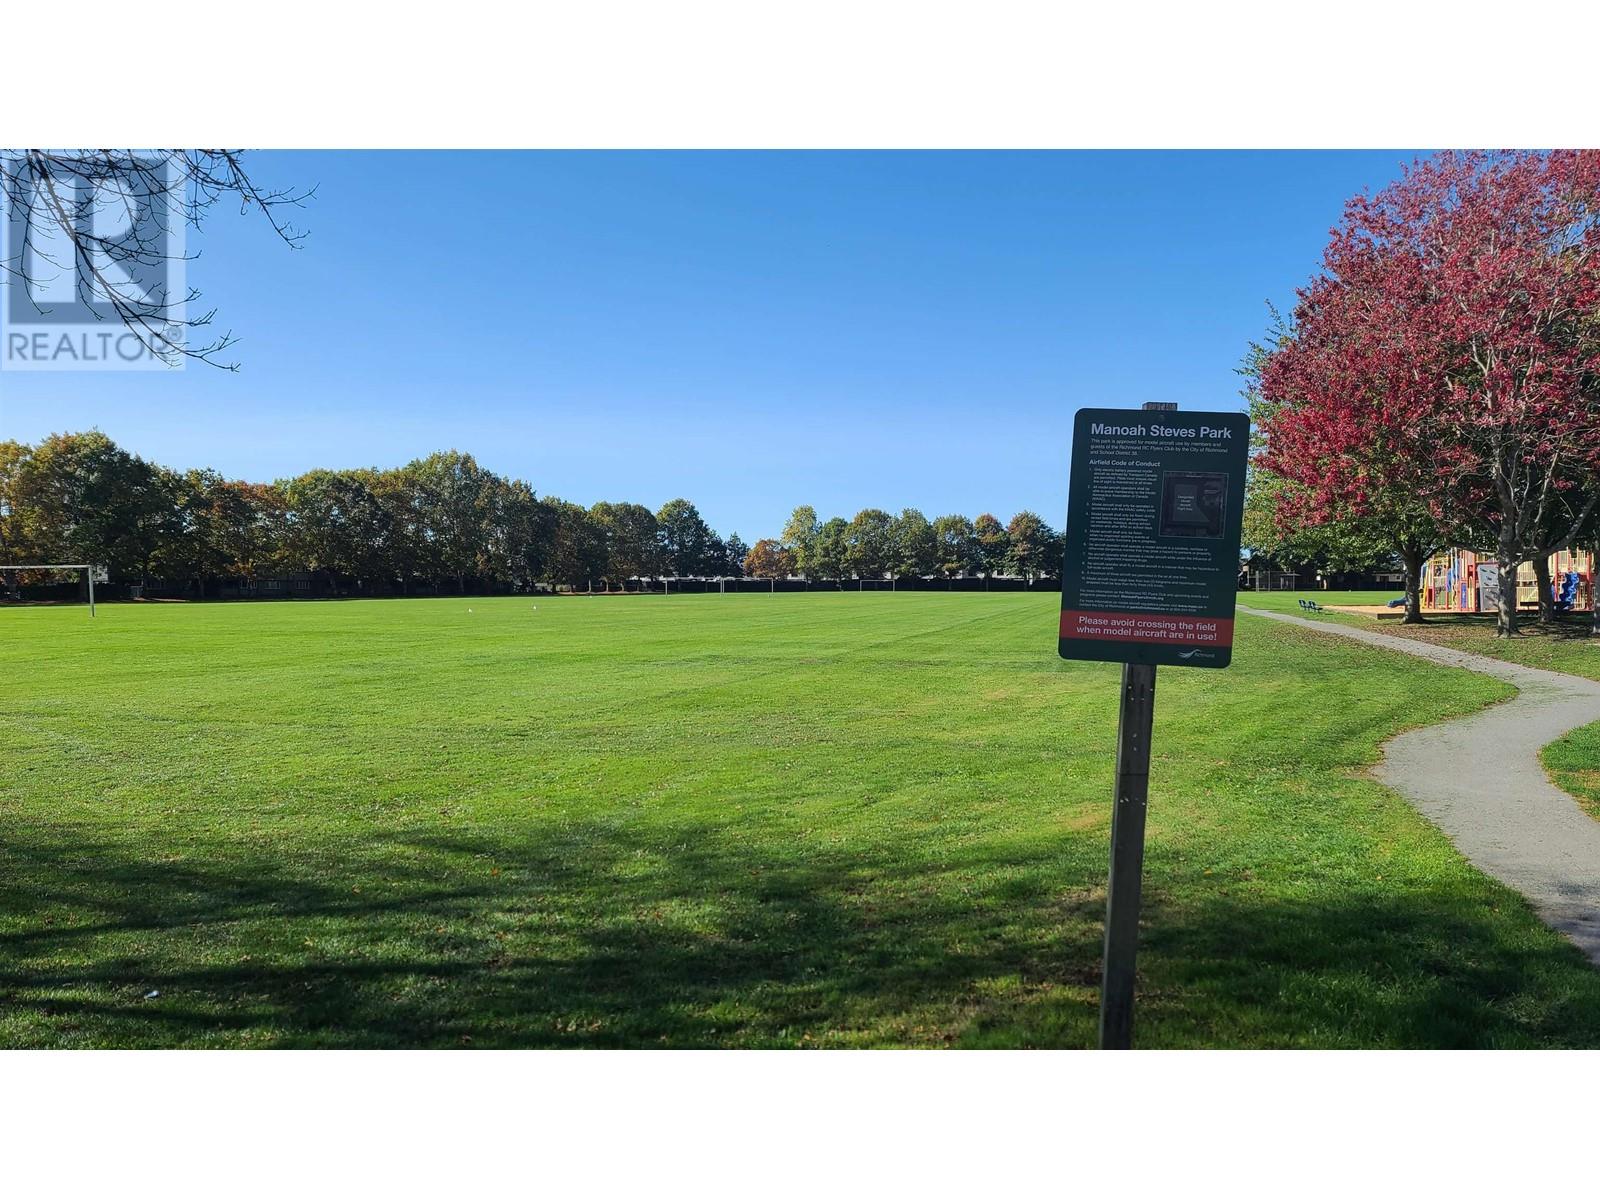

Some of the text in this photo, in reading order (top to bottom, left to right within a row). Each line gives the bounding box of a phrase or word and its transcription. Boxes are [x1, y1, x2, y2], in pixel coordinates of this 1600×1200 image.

[1091, 423, 1232, 439] Manoah Steves Park
[1078, 616, 1216, 632] Please avoid crossing the field
[1076, 626, 1101, 634] when
[1103, 627, 1131, 636] model
[1133, 630, 1166, 638] aircraft
[1186, 631, 1194, 640] in
[1197, 633, 1217, 641] use!
